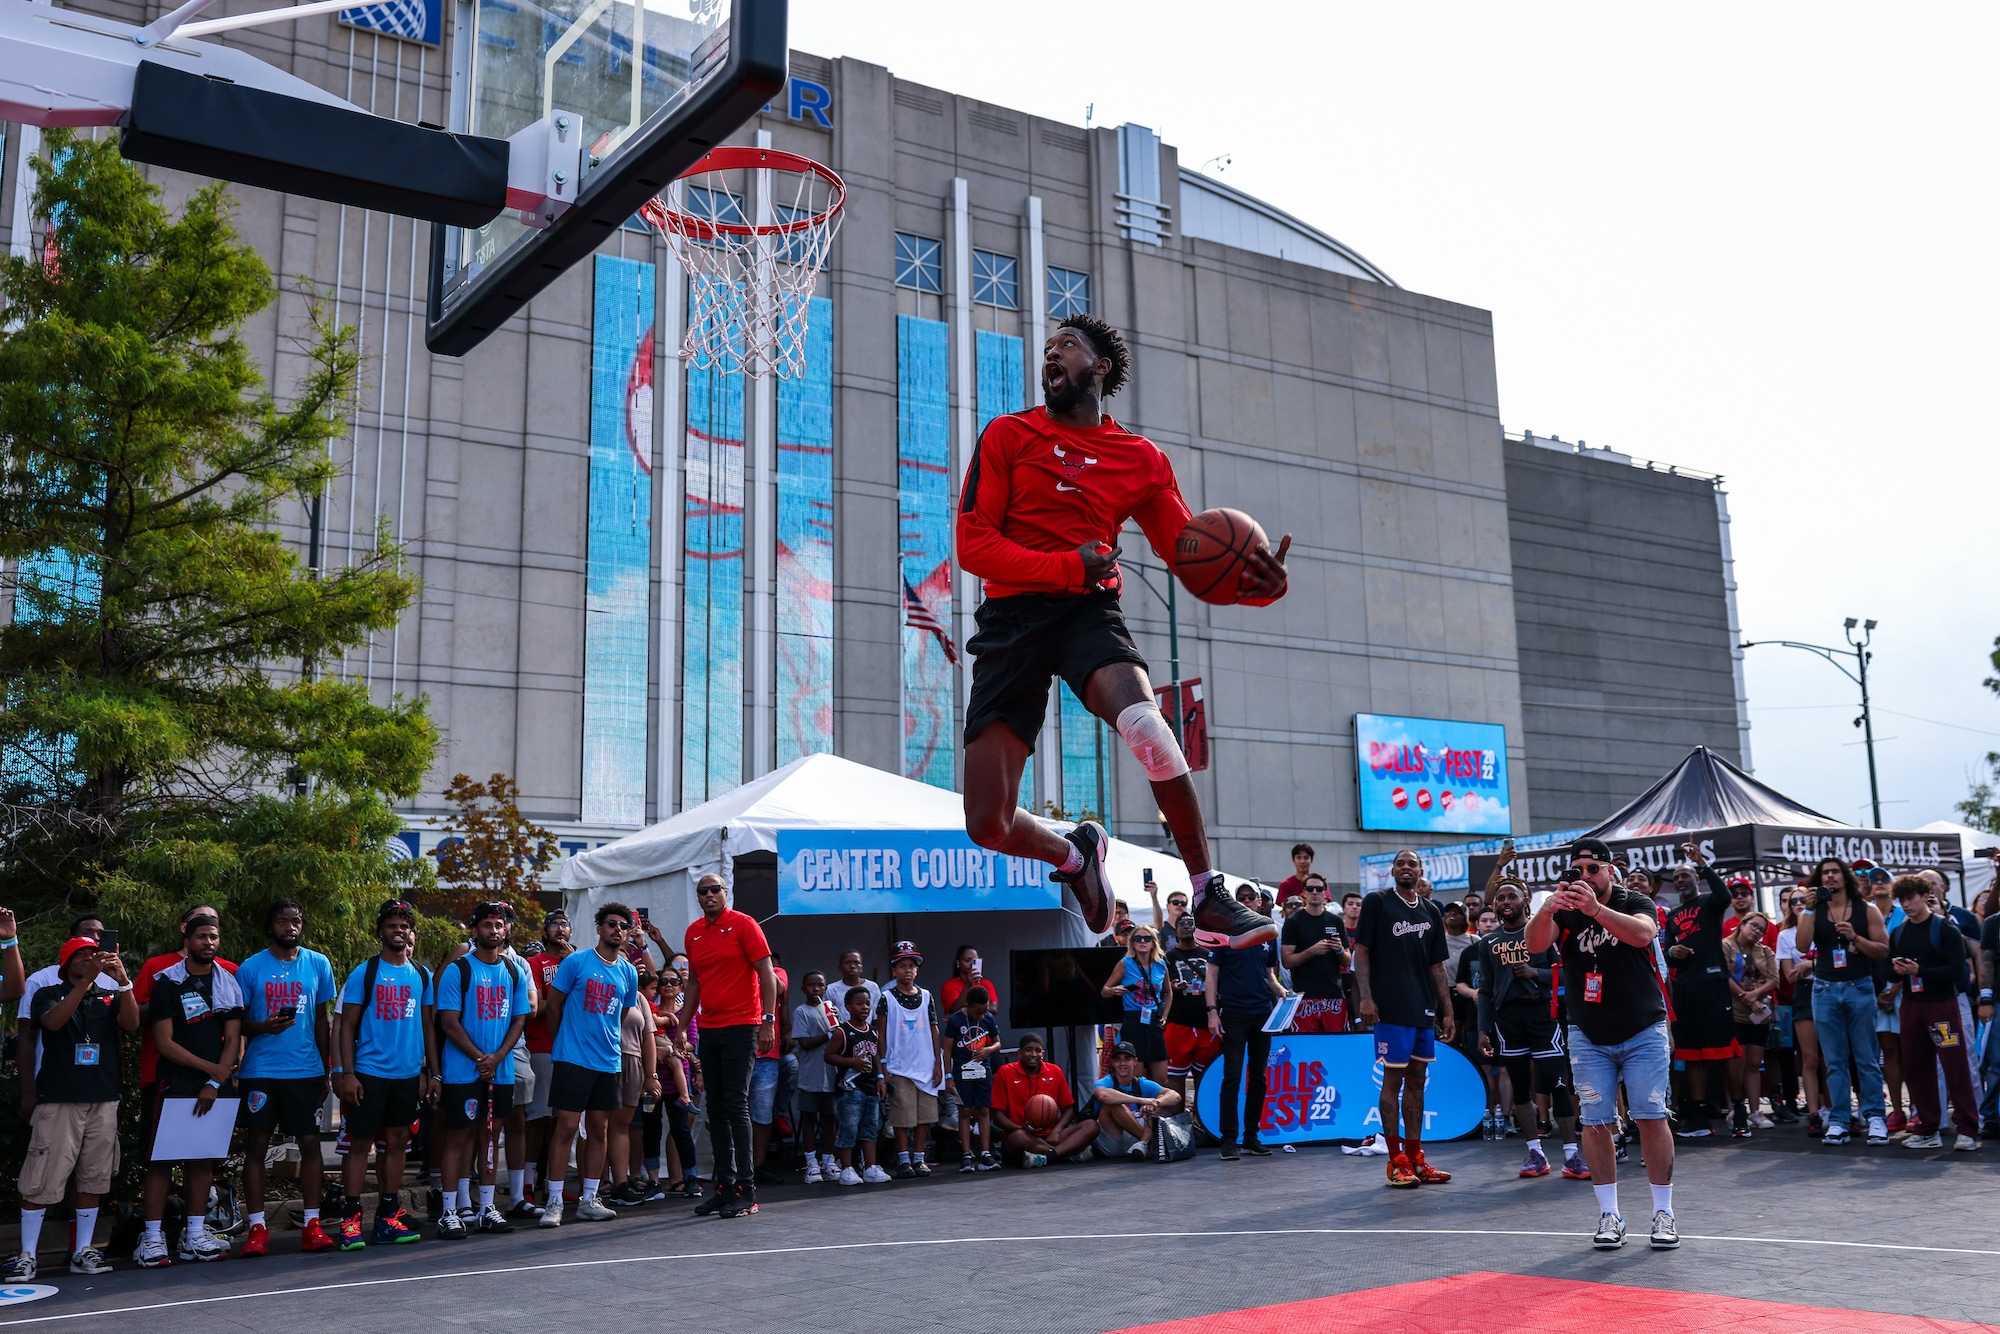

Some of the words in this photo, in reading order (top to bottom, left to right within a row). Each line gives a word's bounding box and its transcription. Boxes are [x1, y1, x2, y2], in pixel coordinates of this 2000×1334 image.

[1369, 741, 1425, 773] BULLS
[1446, 749, 1482, 779] FEST
[1482, 750, 1495, 765] 20
[1481, 765, 1494, 780] 22
[1782, 833, 1875, 862] CHICAGO
[1880, 840, 1941, 866] BULLS
[797, 849, 901, 890] CENTER
[911, 848, 999, 889] COURT
[1006, 857, 1043, 888] HQ
[1673, 906, 1701, 926] BULLS
[1392, 920, 1431, 939] Chicago
[1491, 940, 1528, 955] CHICAG
[1500, 951, 1531, 965] BULLS
[265, 982, 303, 1000] BULLS
[376, 984, 411, 1001] BULLS
[476, 985, 506, 1003] BULLS
[586, 978, 617, 998] BULLS
[298, 995, 308, 1005] 20
[407, 998, 416, 1008] 20
[583, 995, 610, 1016] FEST
[610, 997, 618, 1007] 20
[296, 1004, 305, 1014] 22
[376, 1001, 407, 1021] FEST
[405, 1008, 414, 1018] 22
[606, 1006, 615, 1015] 22
[1264, 1060, 1323, 1095] ULLS
[1315, 1086, 1336, 1103] 20
[1258, 1093, 1314, 1131] EST
[1309, 1103, 1331, 1120] 22
